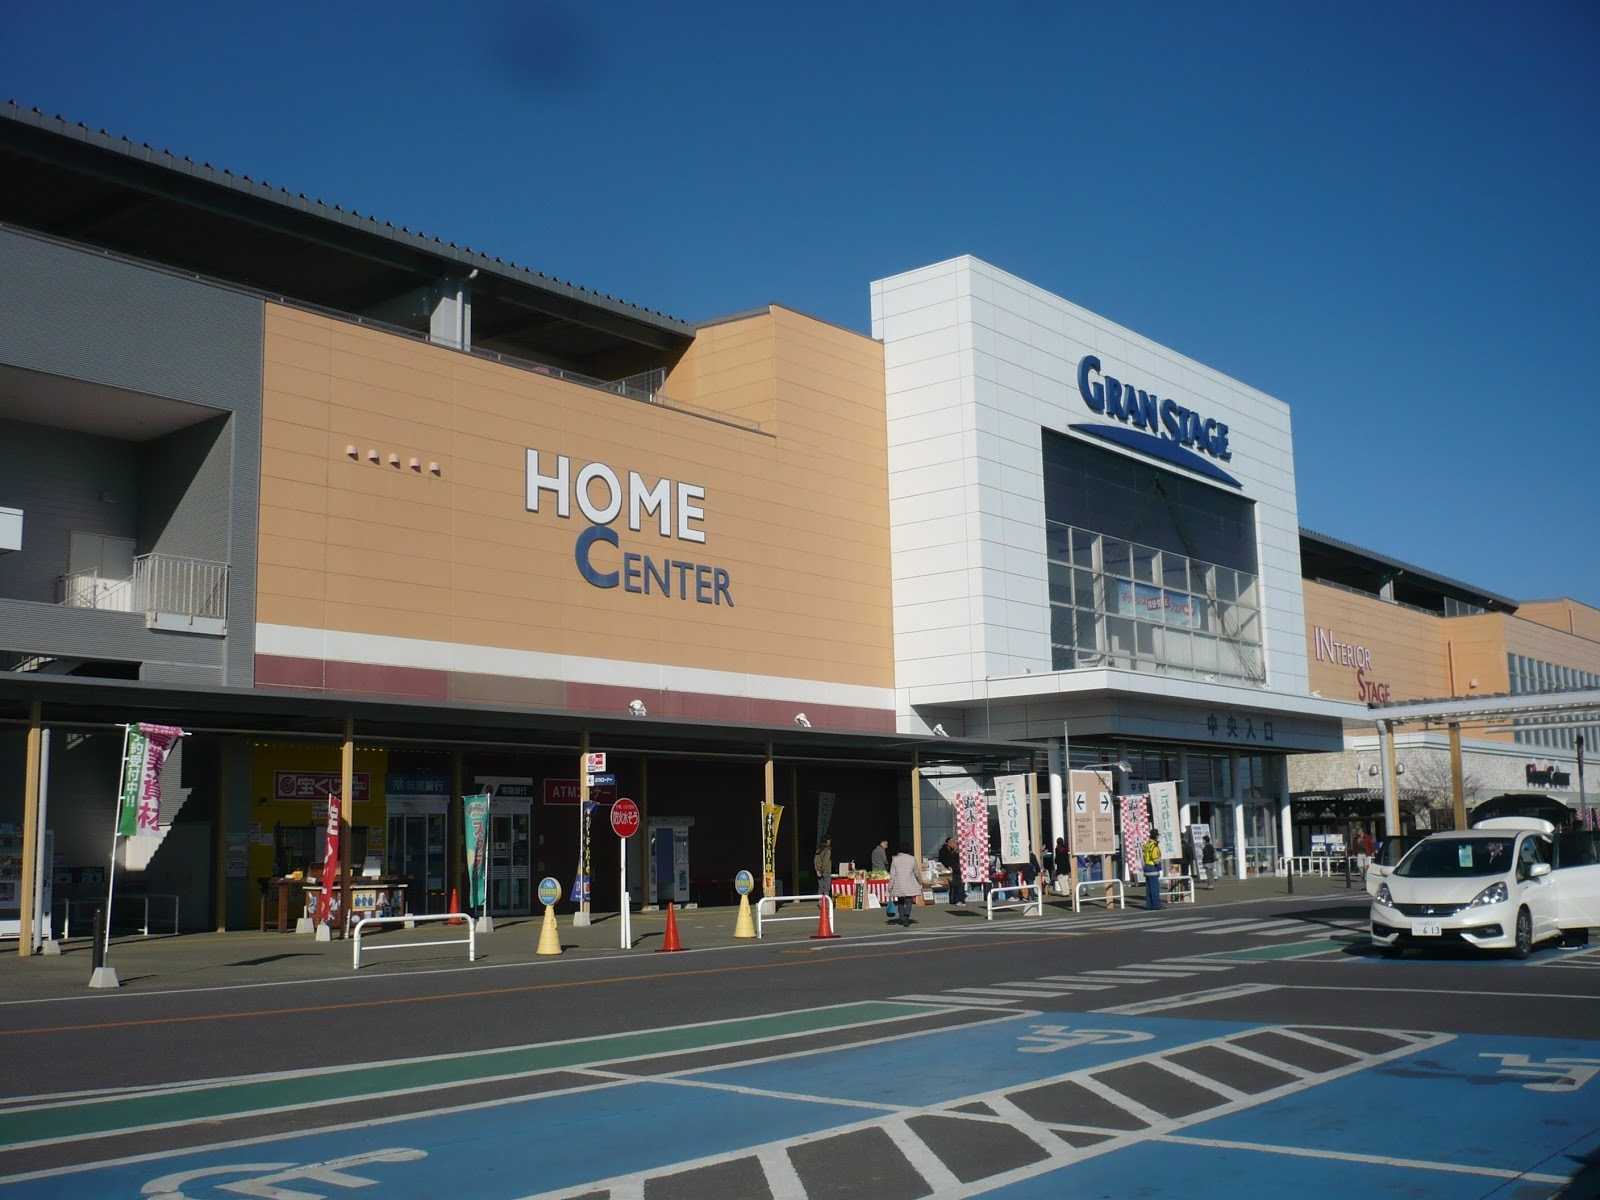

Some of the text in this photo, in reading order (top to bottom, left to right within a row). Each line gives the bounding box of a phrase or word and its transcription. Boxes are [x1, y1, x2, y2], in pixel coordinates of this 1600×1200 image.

[525, 448, 706, 544] HOME
[575, 525, 735, 607] CENTER
[1313, 624, 1372, 672] INTERIOR
[1357, 669, 1391, 704] STAGE
[1207, 712, 1274, 741] 中央入口
